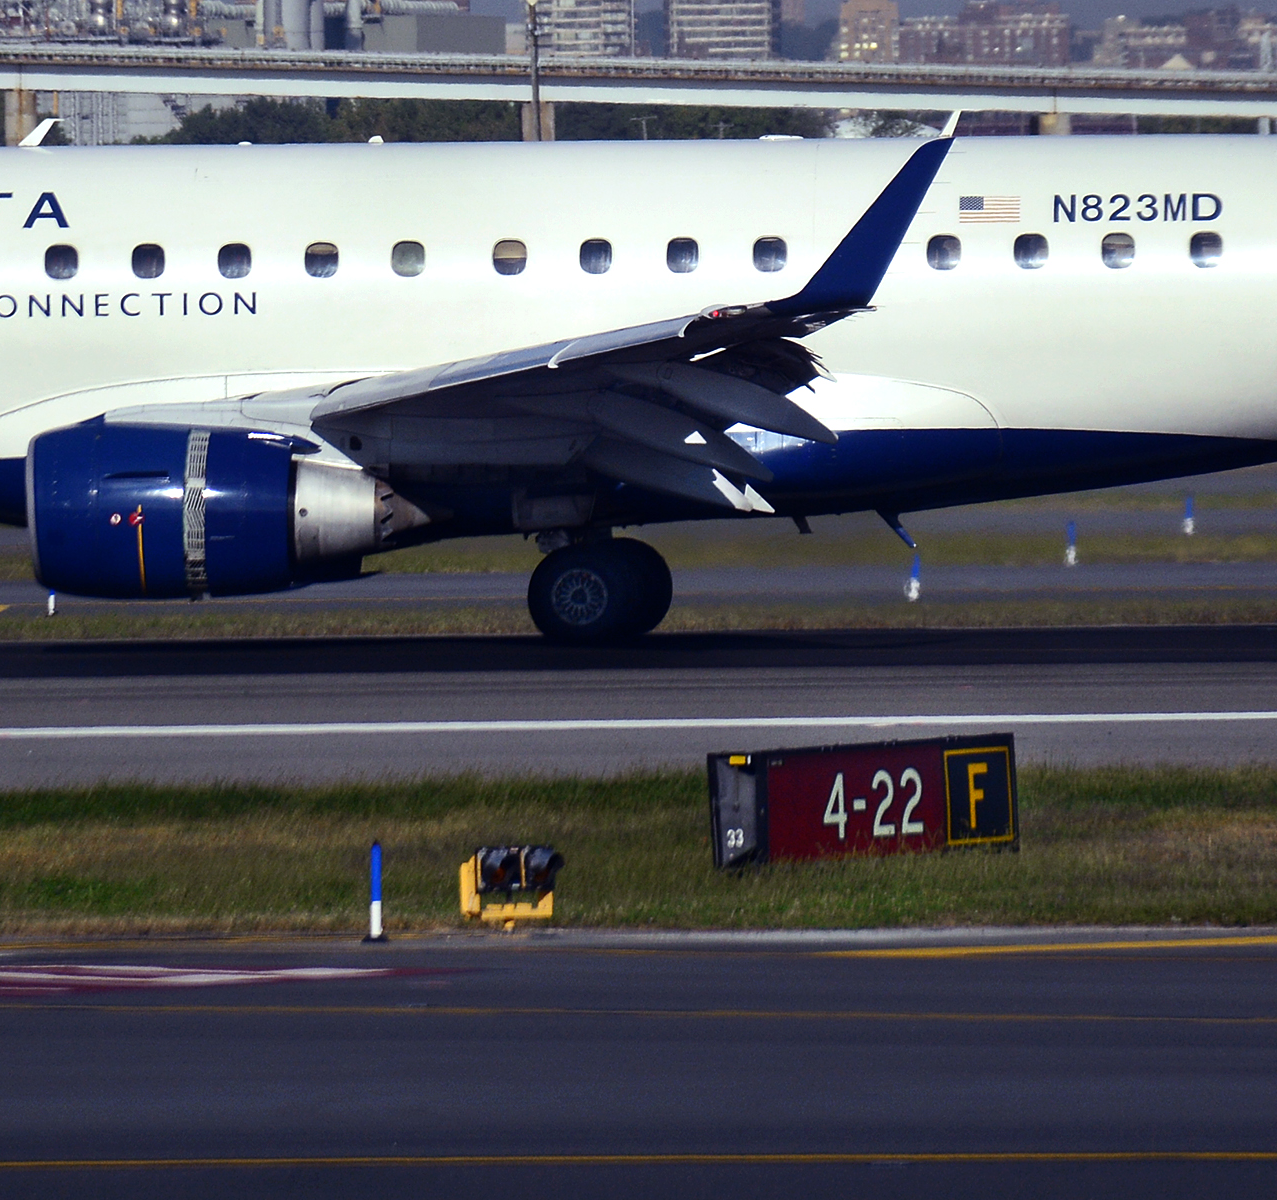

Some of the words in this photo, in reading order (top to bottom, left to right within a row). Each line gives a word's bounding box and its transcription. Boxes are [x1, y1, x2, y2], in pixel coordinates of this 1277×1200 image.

[1052, 193, 1223, 223] N823MD
[823, 767, 925, 840] 4-22
[967, 762, 988, 829] F
